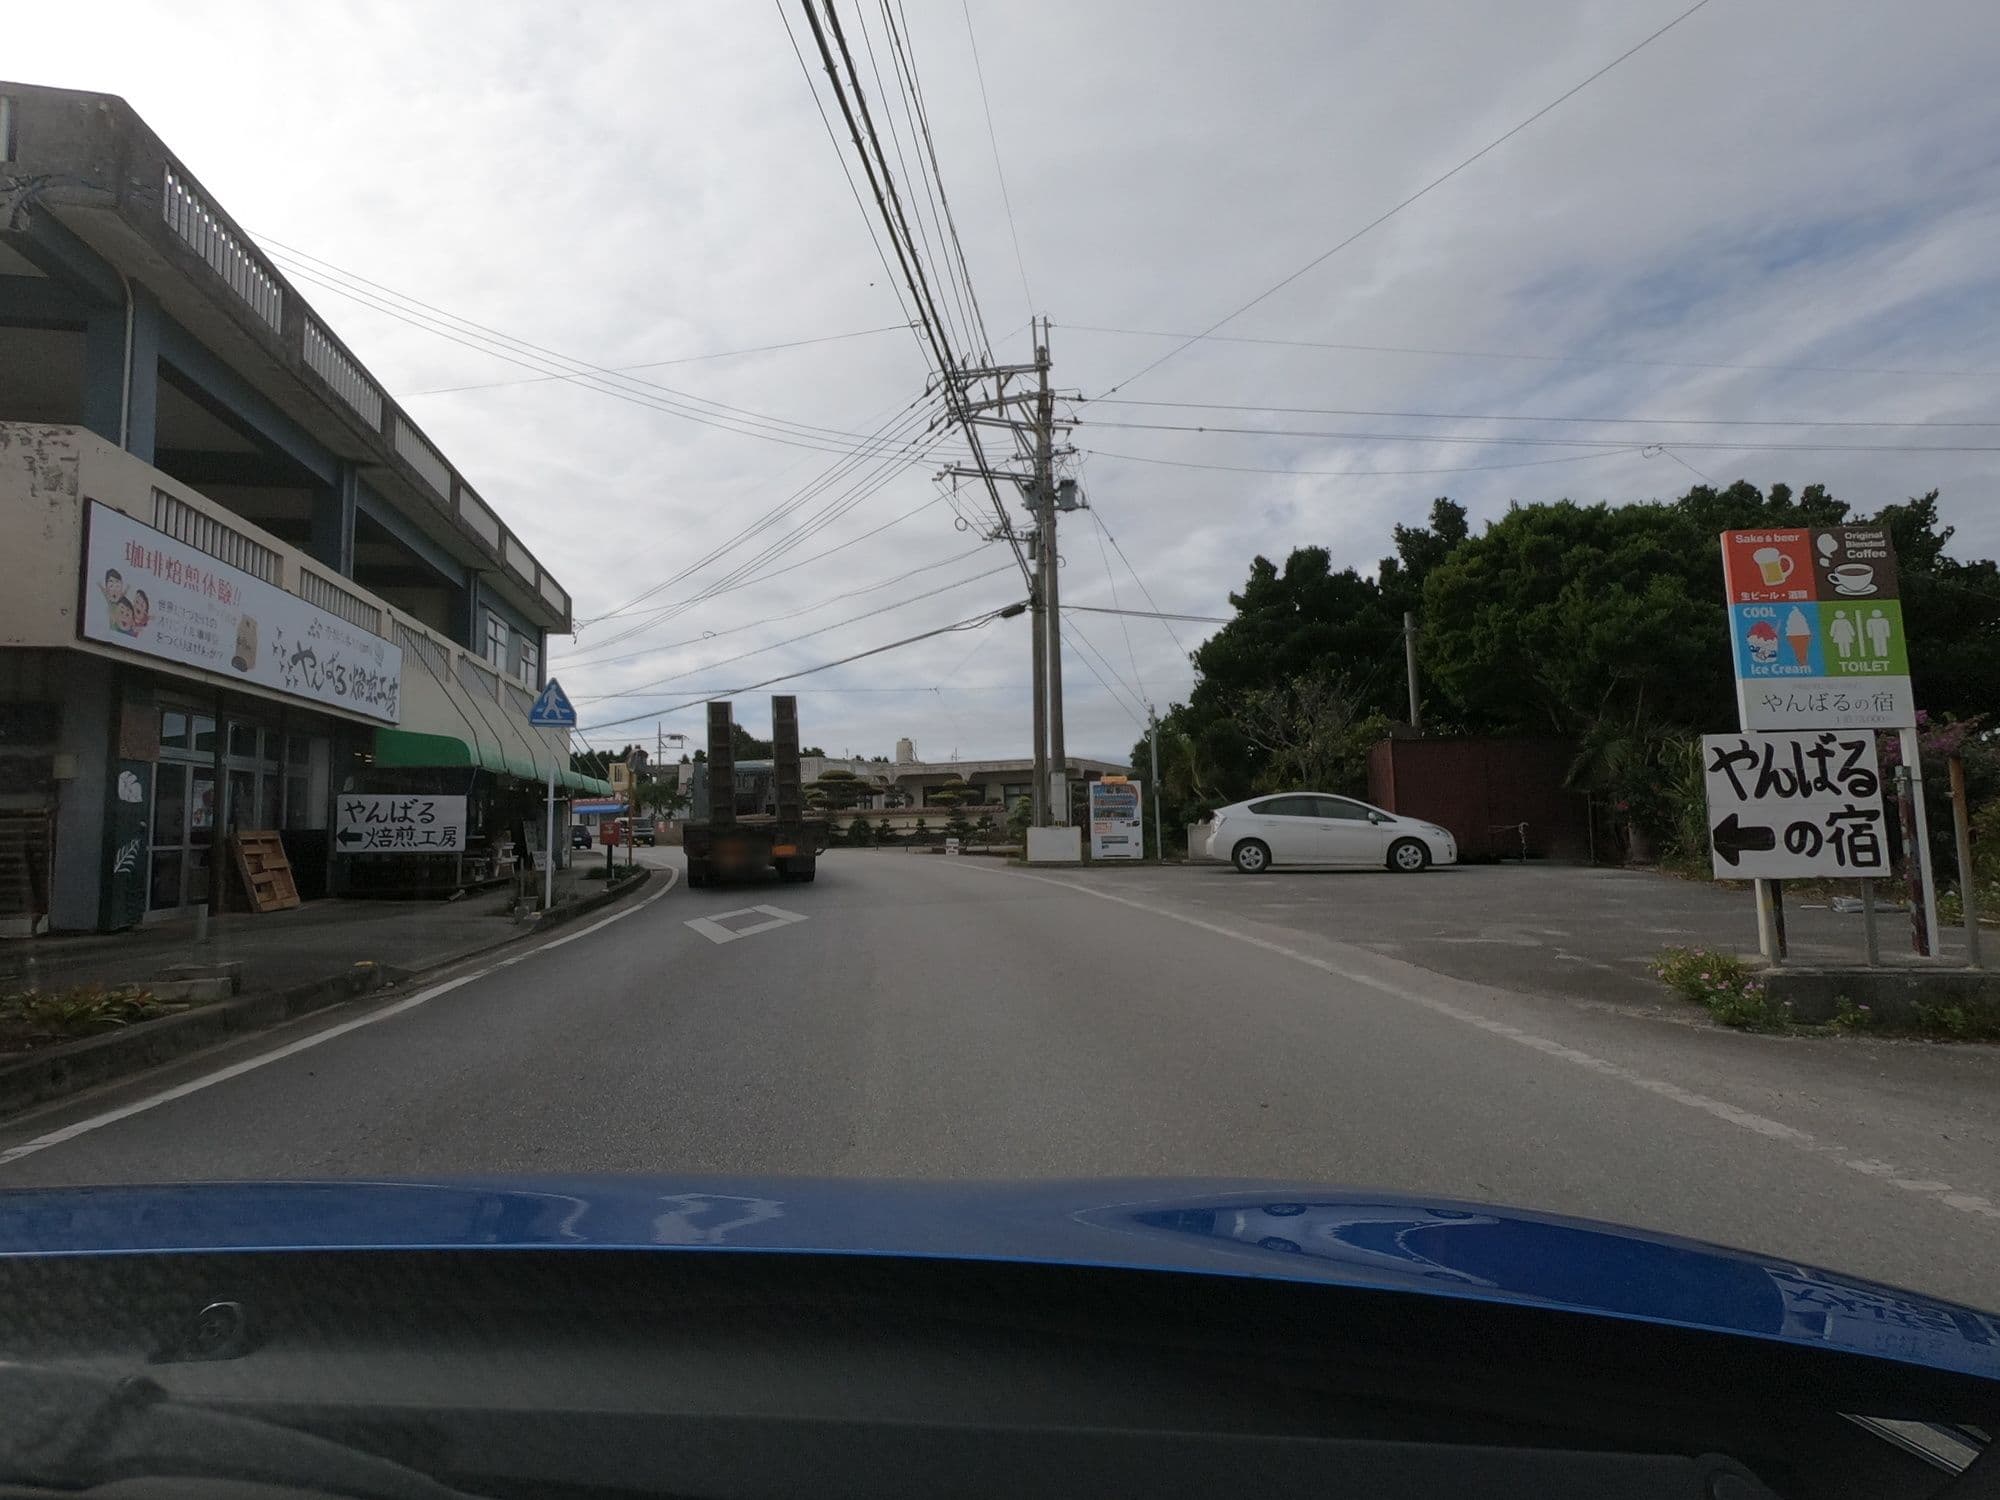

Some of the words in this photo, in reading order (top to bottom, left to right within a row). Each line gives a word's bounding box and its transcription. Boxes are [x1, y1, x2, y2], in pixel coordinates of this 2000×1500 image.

[1735, 534, 1764, 544] Sake
[1773, 533, 1800, 543] beer
[1844, 531, 1883, 541] Original
[1846, 549, 1887, 559] Coffee
[1743, 607, 1777, 618] COOL
[1751, 663, 1767, 675] Ice
[1771, 662, 1812, 674] Cream
[1839, 660, 1890, 673] TOILET
[1761, 691, 1895, 713] やんばるの宿
[1708, 732, 1878, 802] やんばる
[345, 798, 436, 824] やんばる
[363, 825, 458, 849] 焙煎工房
[1784, 804, 1883, 868] の宿
